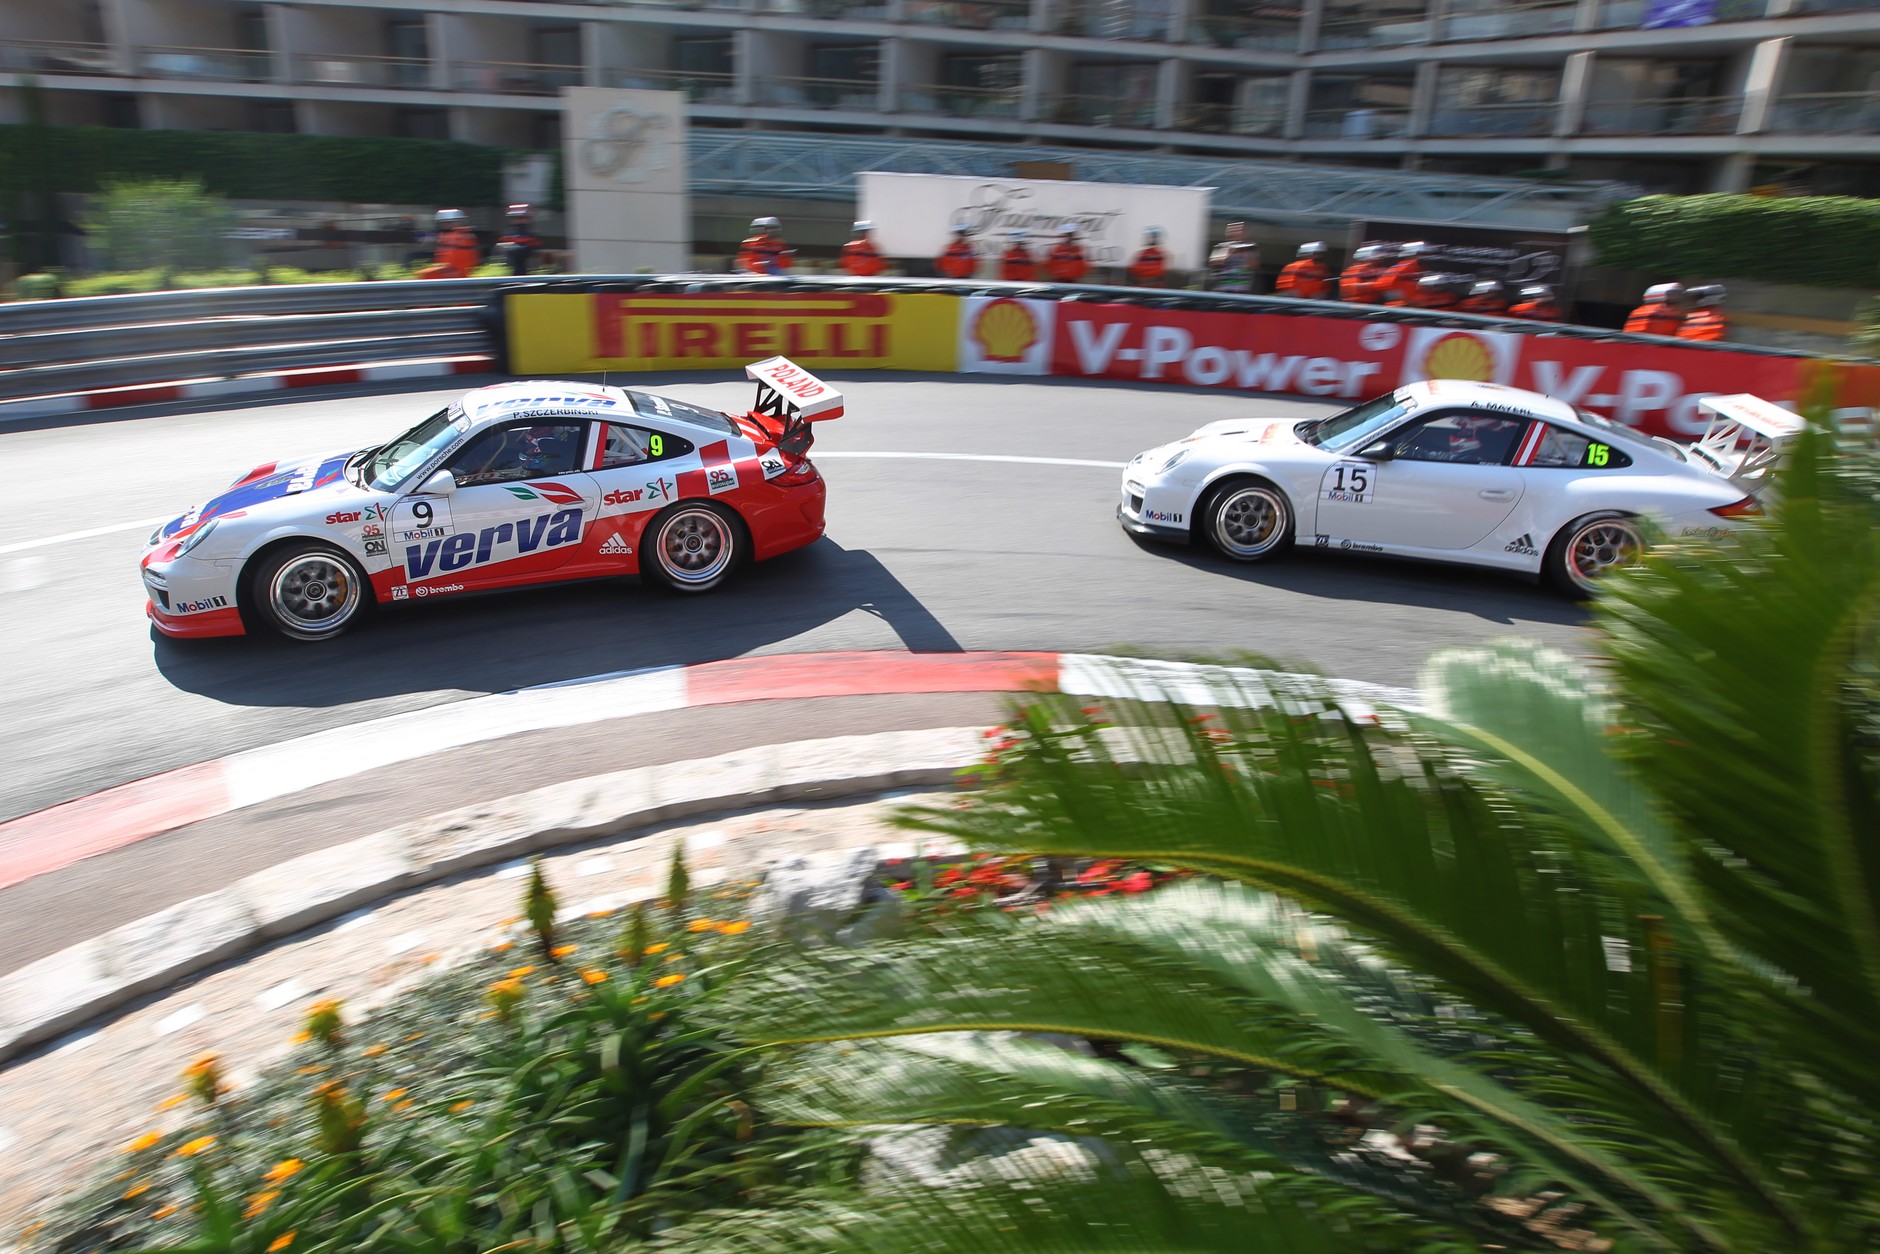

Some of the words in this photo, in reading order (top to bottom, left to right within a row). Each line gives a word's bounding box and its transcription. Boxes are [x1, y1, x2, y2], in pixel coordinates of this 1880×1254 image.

[950, 183, 1128, 237] Fairmont
[590, 292, 894, 358] PIRELLI
[1066, 319, 1384, 398] V-Power
[764, 363, 825, 398] POLAND
[650, 435, 664, 456] 9
[416, 438, 465, 481] www.porsche.com
[1587, 443, 1610, 467] 15
[710, 470, 729, 482] 95
[1333, 467, 1367, 492] 15
[603, 489, 643, 507] star
[1328, 491, 1354, 502] Mobil
[325, 511, 362, 525] star
[412, 502, 433, 528] 9
[1145, 510, 1172, 522] Mobil
[363, 525, 381, 537] 95
[404, 530, 434, 540] Mobil
[364, 540, 387, 553] ON
[406, 508, 583, 579] verva
[599, 546, 633, 555] adidas
[1352, 541, 1384, 552] brembo
[1504, 545, 1539, 556] adidas
[429, 584, 464, 594] brembo
[176, 598, 213, 613] Mobil
